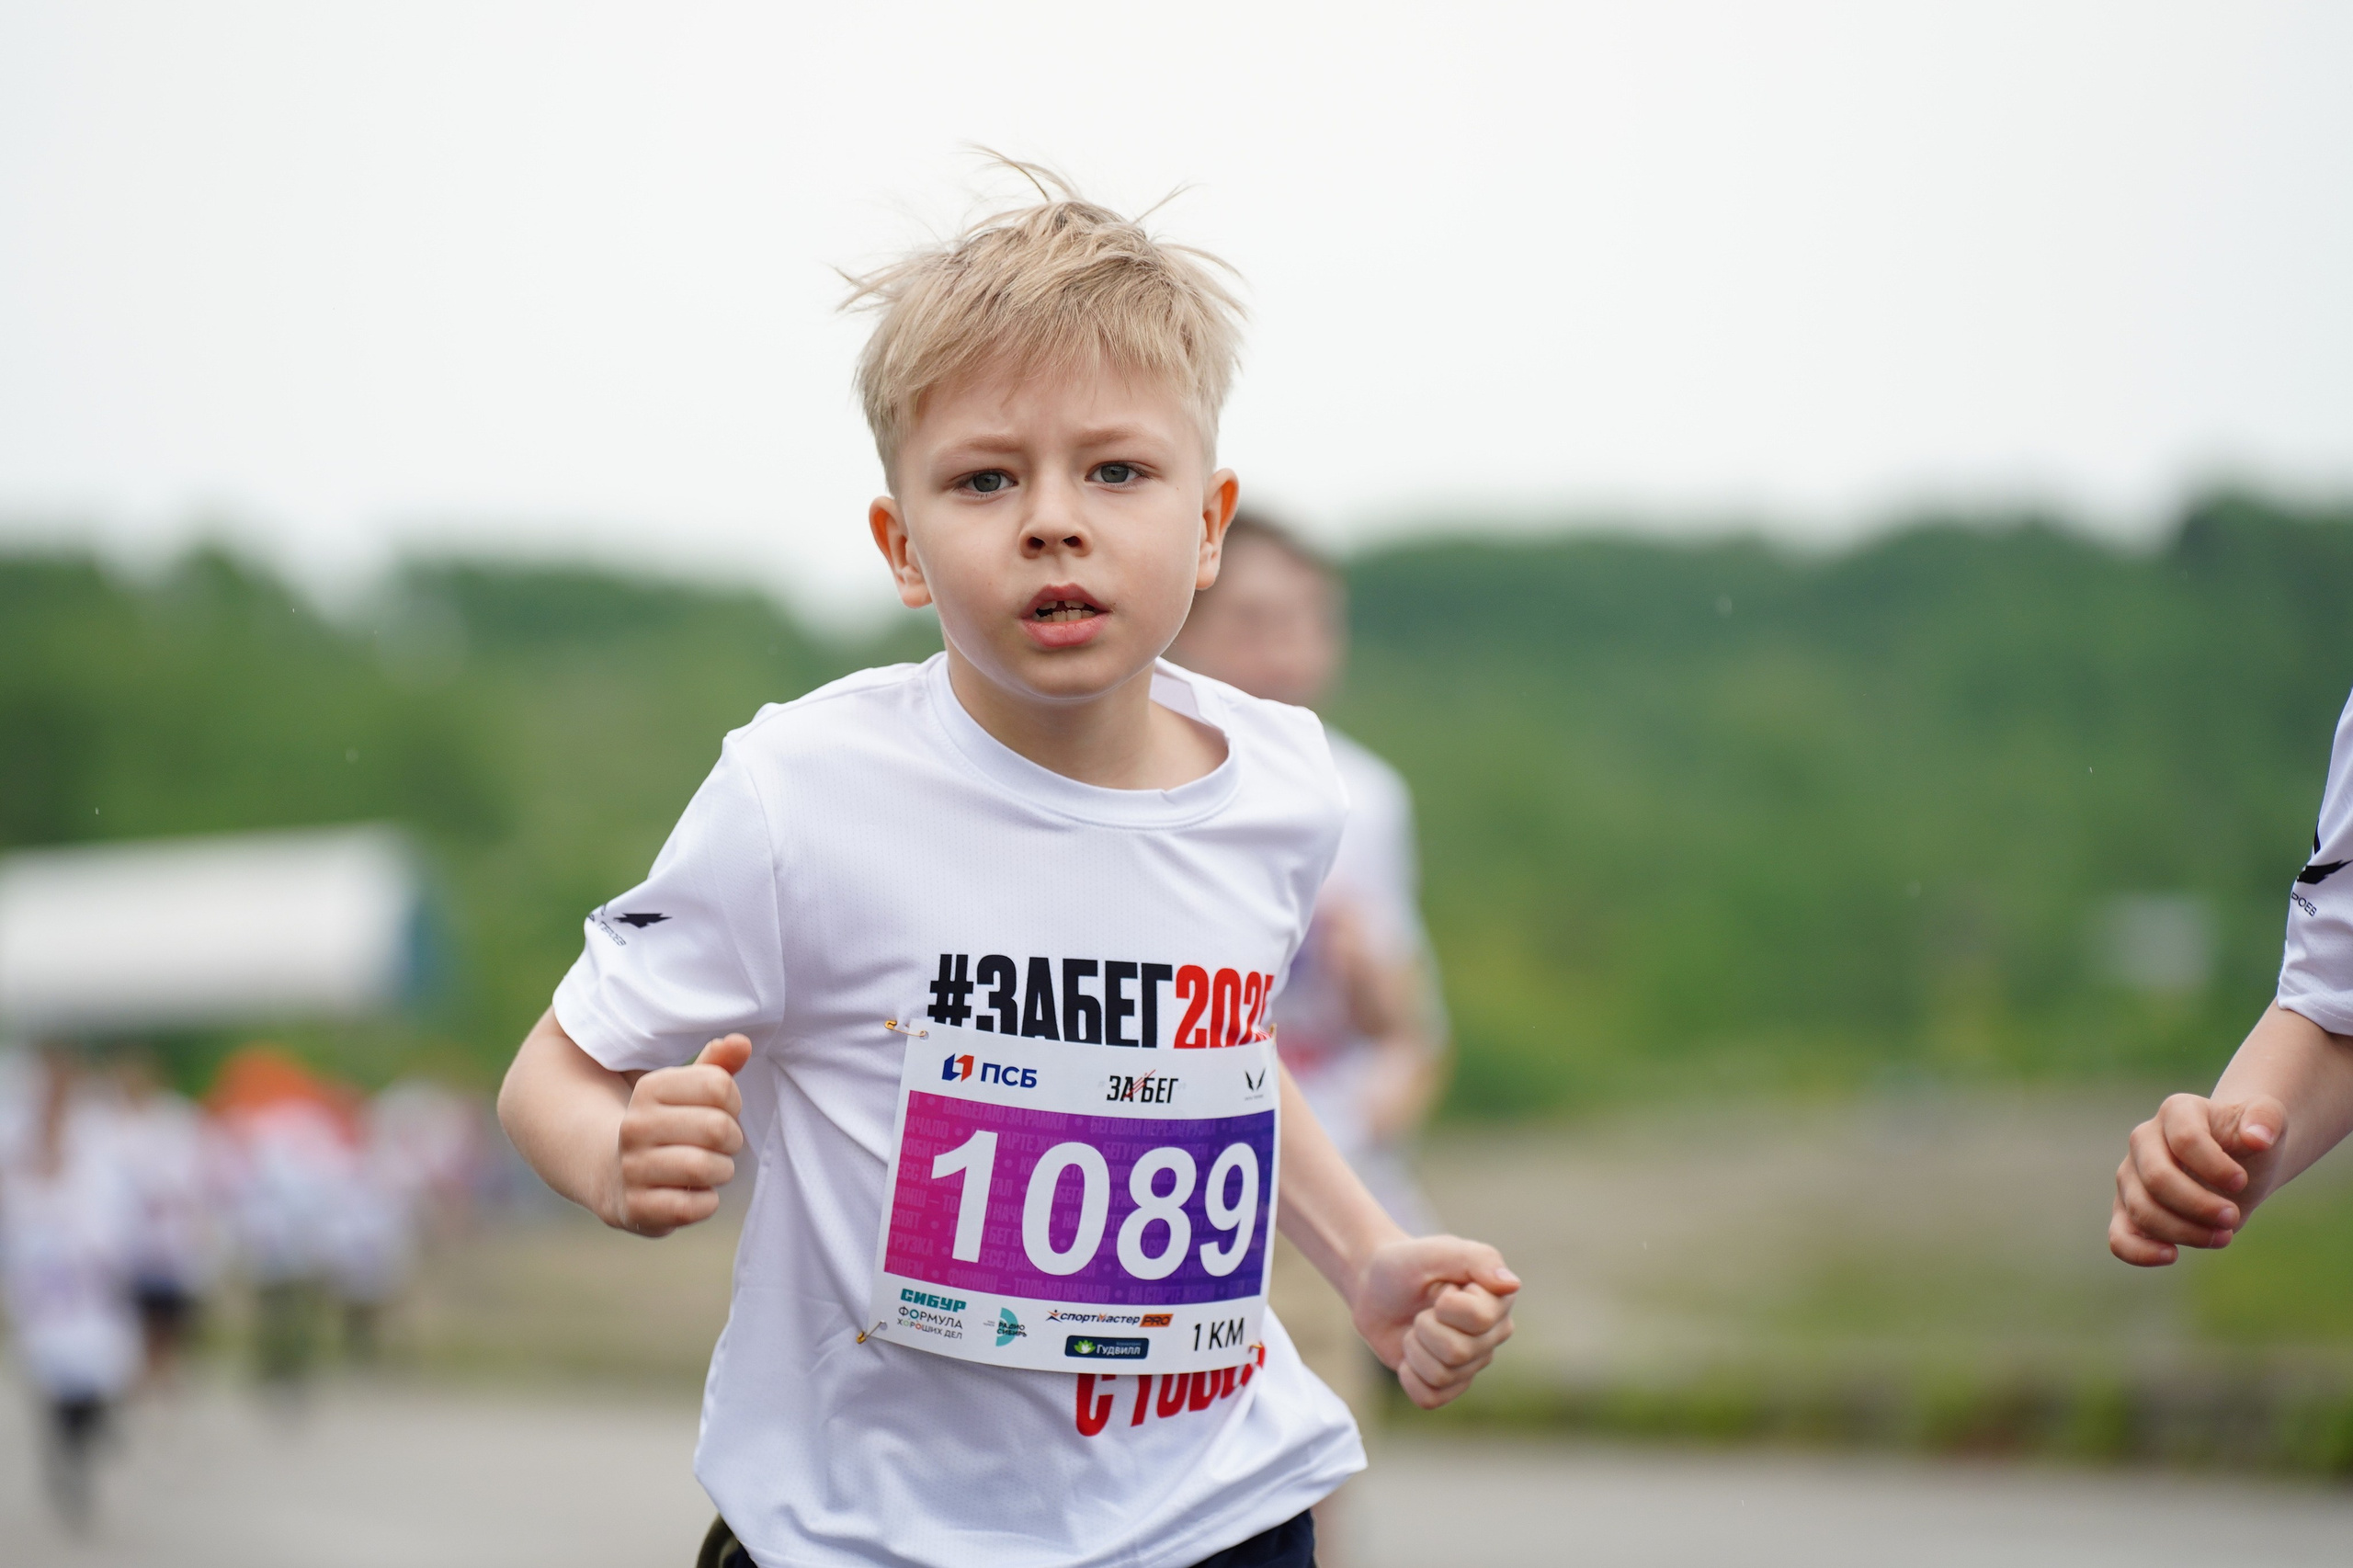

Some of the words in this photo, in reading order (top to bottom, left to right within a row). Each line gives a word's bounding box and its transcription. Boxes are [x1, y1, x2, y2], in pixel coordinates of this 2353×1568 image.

[980, 1062, 1038, 1089] ПСБ
[930, 1130, 1259, 1281] 1089
[900, 1289, 967, 1312] СИБУР
[896, 1318, 943, 1335] ХОРОШИХ
[943, 1329, 963, 1340] ДЕЛ
[898, 1306, 963, 1329] ФОРМУЛА
[1142, 1315, 1171, 1326] PRO
[1194, 1323, 1203, 1352] 1
[1209, 1317, 1245, 1350] КМ
